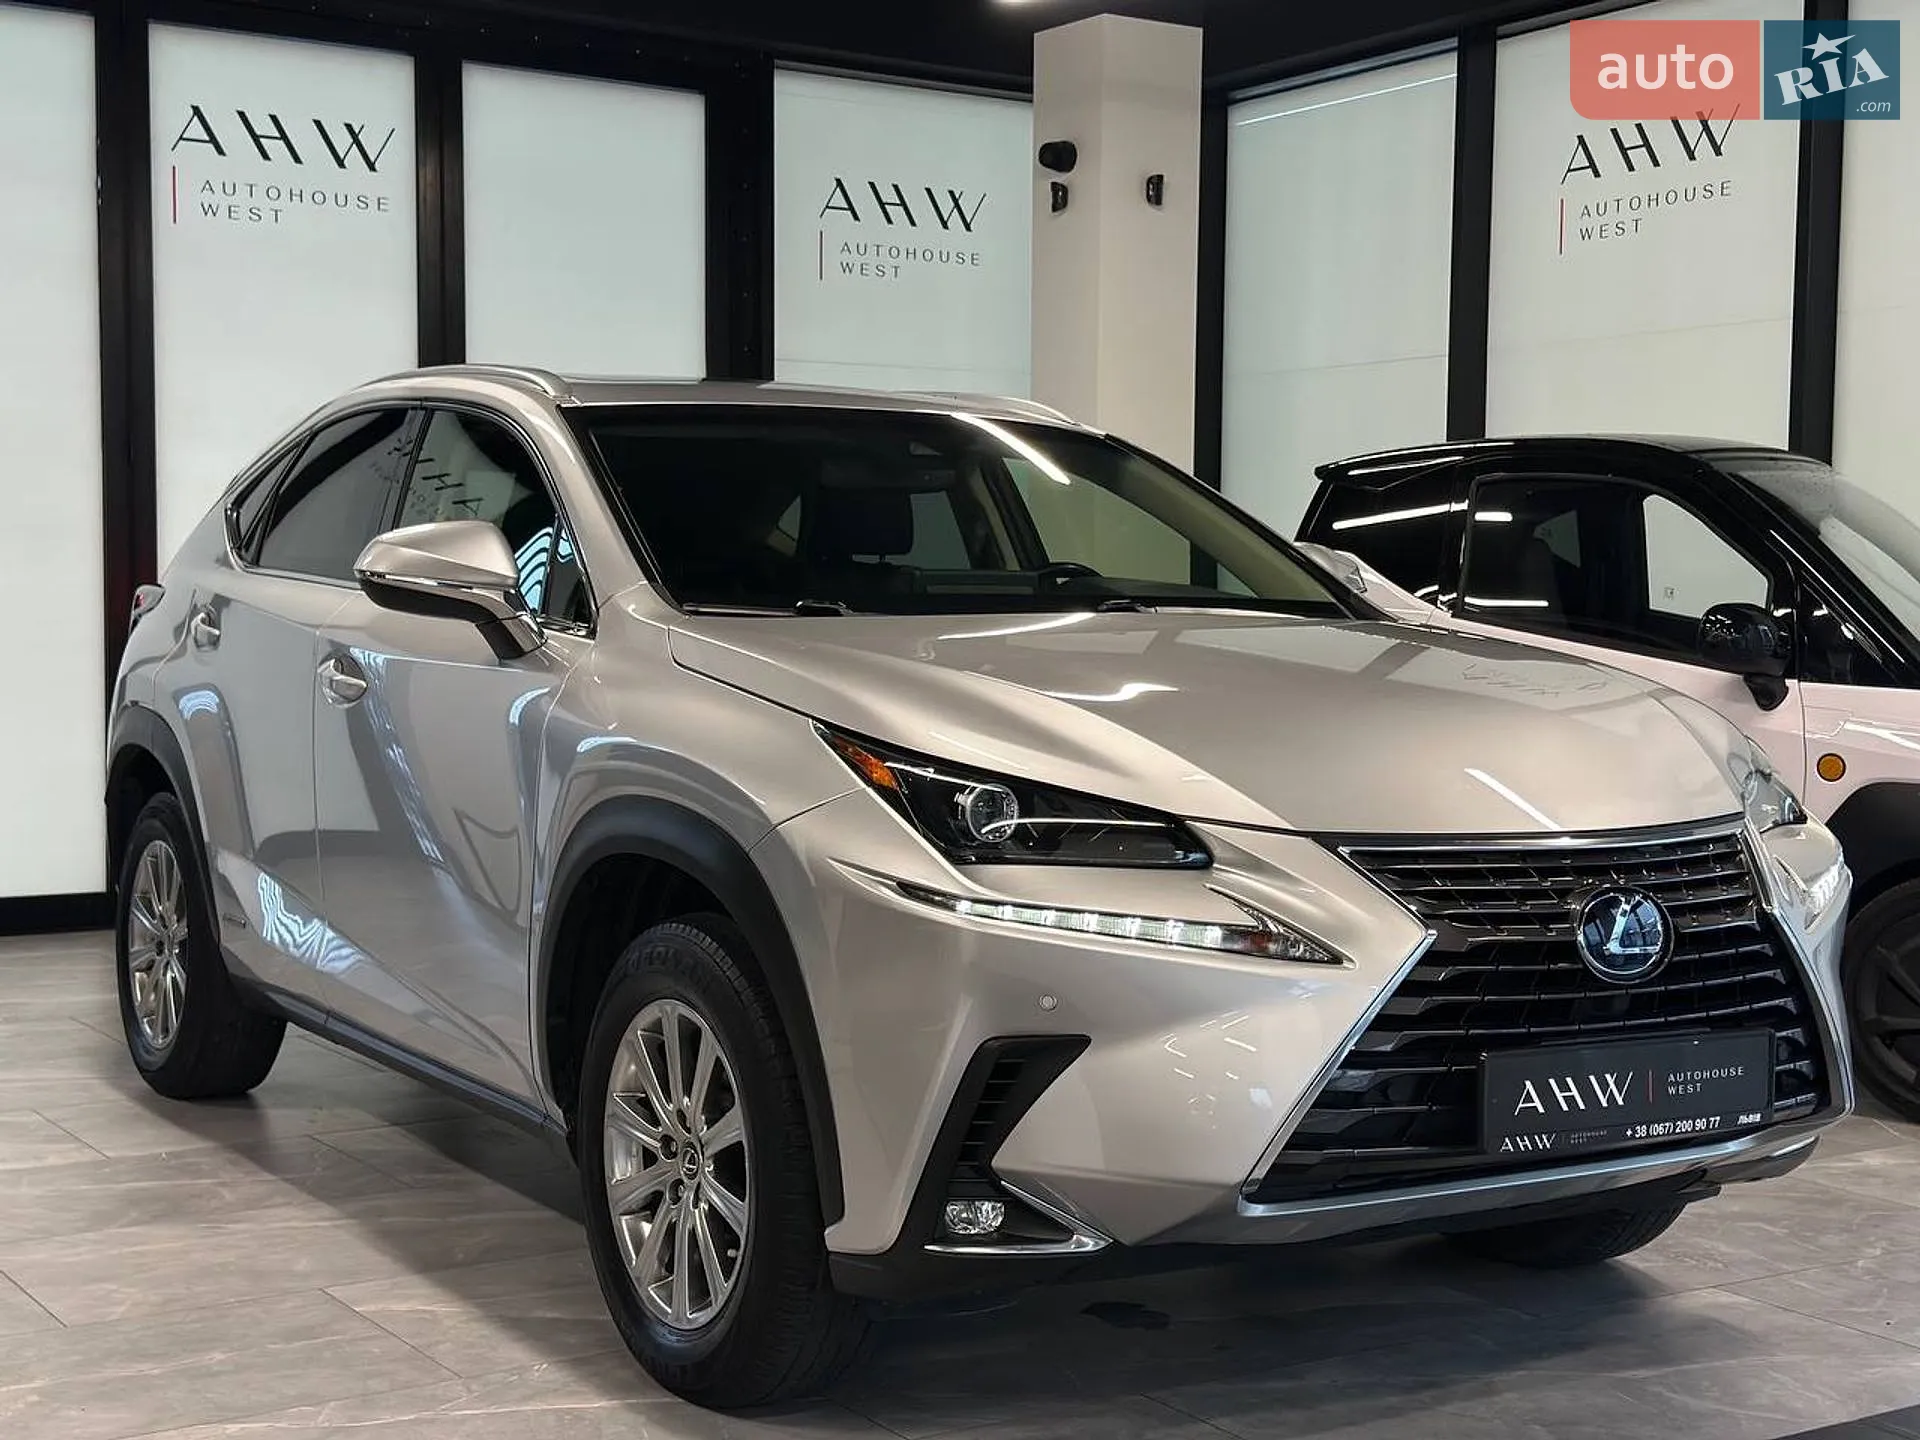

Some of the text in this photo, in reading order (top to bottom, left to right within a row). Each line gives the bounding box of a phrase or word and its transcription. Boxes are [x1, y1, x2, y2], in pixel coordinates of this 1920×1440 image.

[171, 104, 396, 173] AHW
[1561, 103, 1741, 185] AHW
[201, 179, 390, 213] AUTOHOUSE
[819, 177, 987, 233] AHW
[1580, 180, 1733, 220] AUTOHOUSE
[201, 203, 283, 224] WEST
[1579, 218, 1643, 242] WEST
[840, 241, 982, 267] AUTOHOUSE
[840, 261, 900, 279] WEST
[1667, 1066, 1745, 1083] AUTOHOUSE
[1514, 1071, 1634, 1116] AHW
[1667, 1082, 1702, 1096] WEST
[1635, 1125, 1647, 1138] 38
[1649, 1122, 1673, 1136] (067)
[1675, 1120, 1693, 1133] 200
[1695, 1118, 1707, 1131] 90
[1709, 1116, 1720, 1129] 77
[1500, 1133, 1557, 1153] AHW
